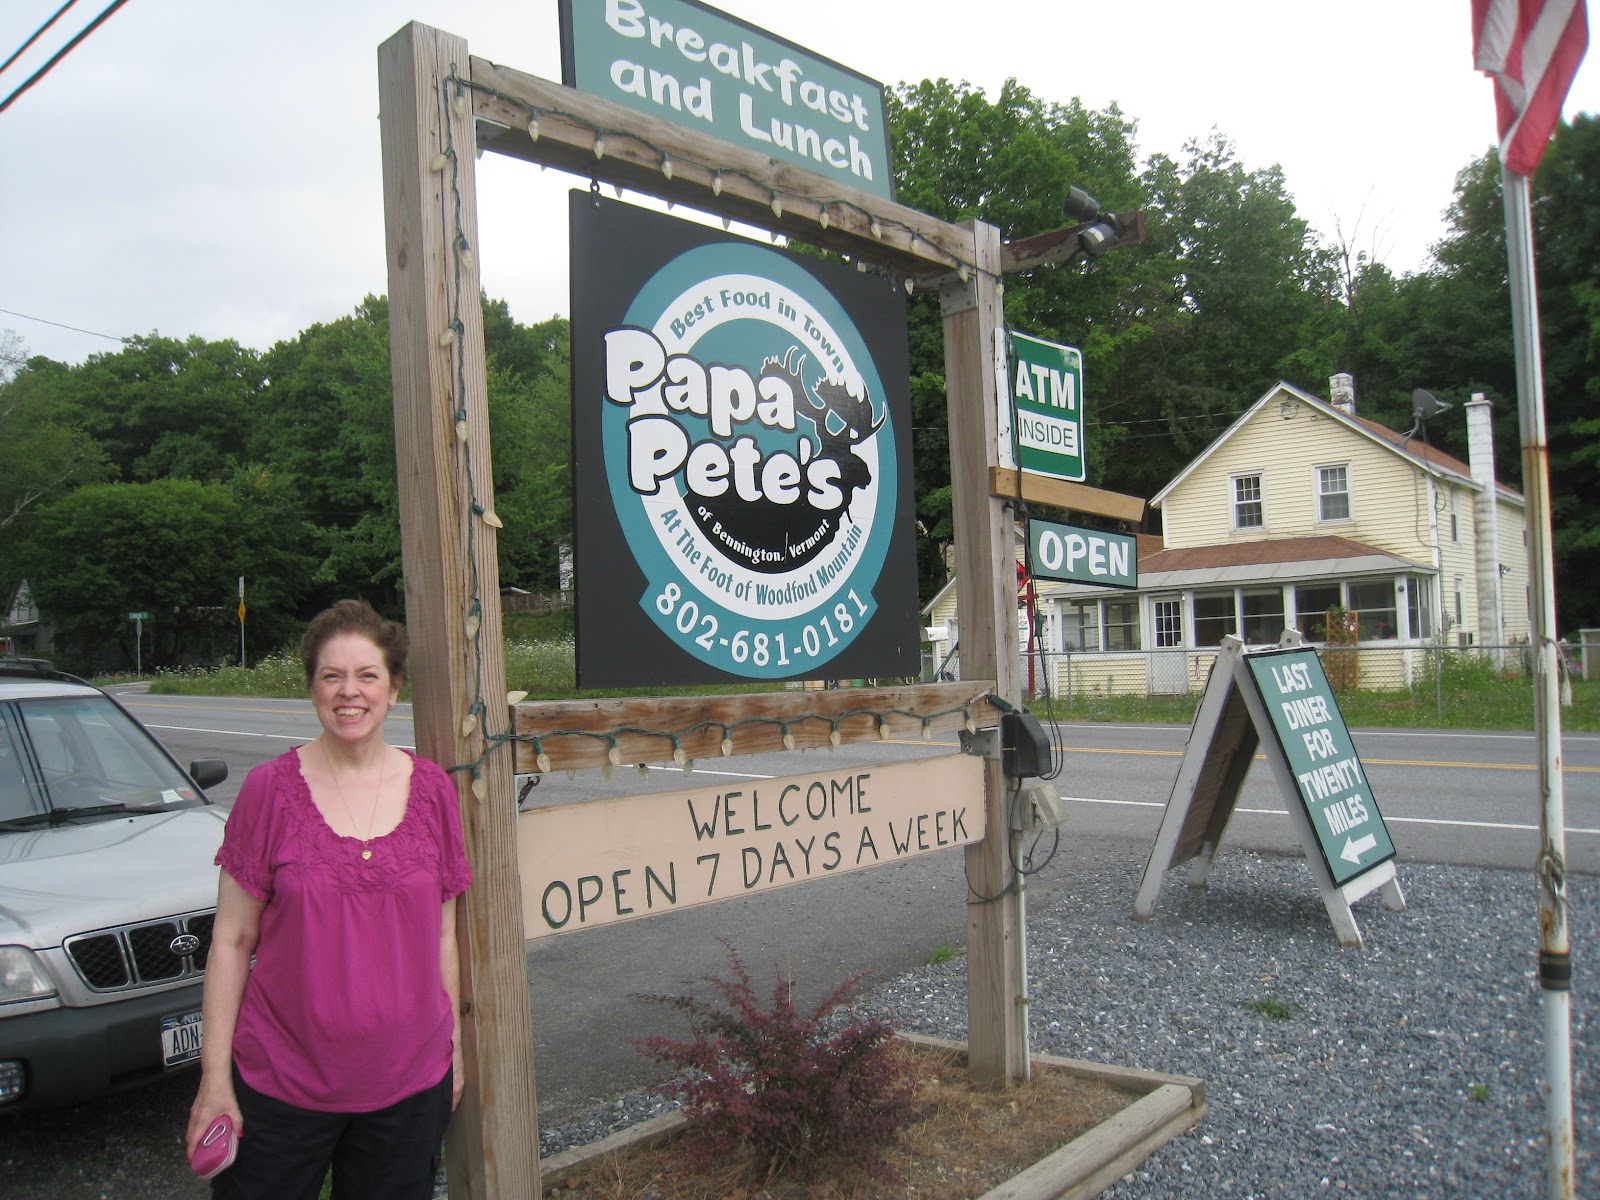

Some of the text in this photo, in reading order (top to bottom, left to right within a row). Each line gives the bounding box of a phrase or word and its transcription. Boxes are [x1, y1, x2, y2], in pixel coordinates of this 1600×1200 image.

[604, 0, 870, 132] Breakfast
[609, 59, 873, 182] and Lunch
[669, 289, 845, 374] Best Food in Town
[603, 328, 797, 438] Papa
[1015, 358, 1075, 411] ATM
[1018, 415, 1075, 449] INSIDE
[628, 417, 844, 511] Pete's
[660, 508, 863, 606] At The Foot of Woodford Mountain
[697, 505, 714, 522] of
[788, 518, 830, 559] Vermont
[1038, 529, 1129, 577] OPEN
[655, 581, 869, 667] 802-681-0181
[1271, 661, 1313, 694] LAST
[1280, 695, 1333, 731] DINER
[1302, 728, 1338, 762] FOR
[686, 773, 873, 842] WELCOME
[1298, 756, 1362, 803] TWENTY
[1323, 793, 1369, 837] MILES
[540, 806, 969, 930] OPEN 7 DAYS A WEEK
